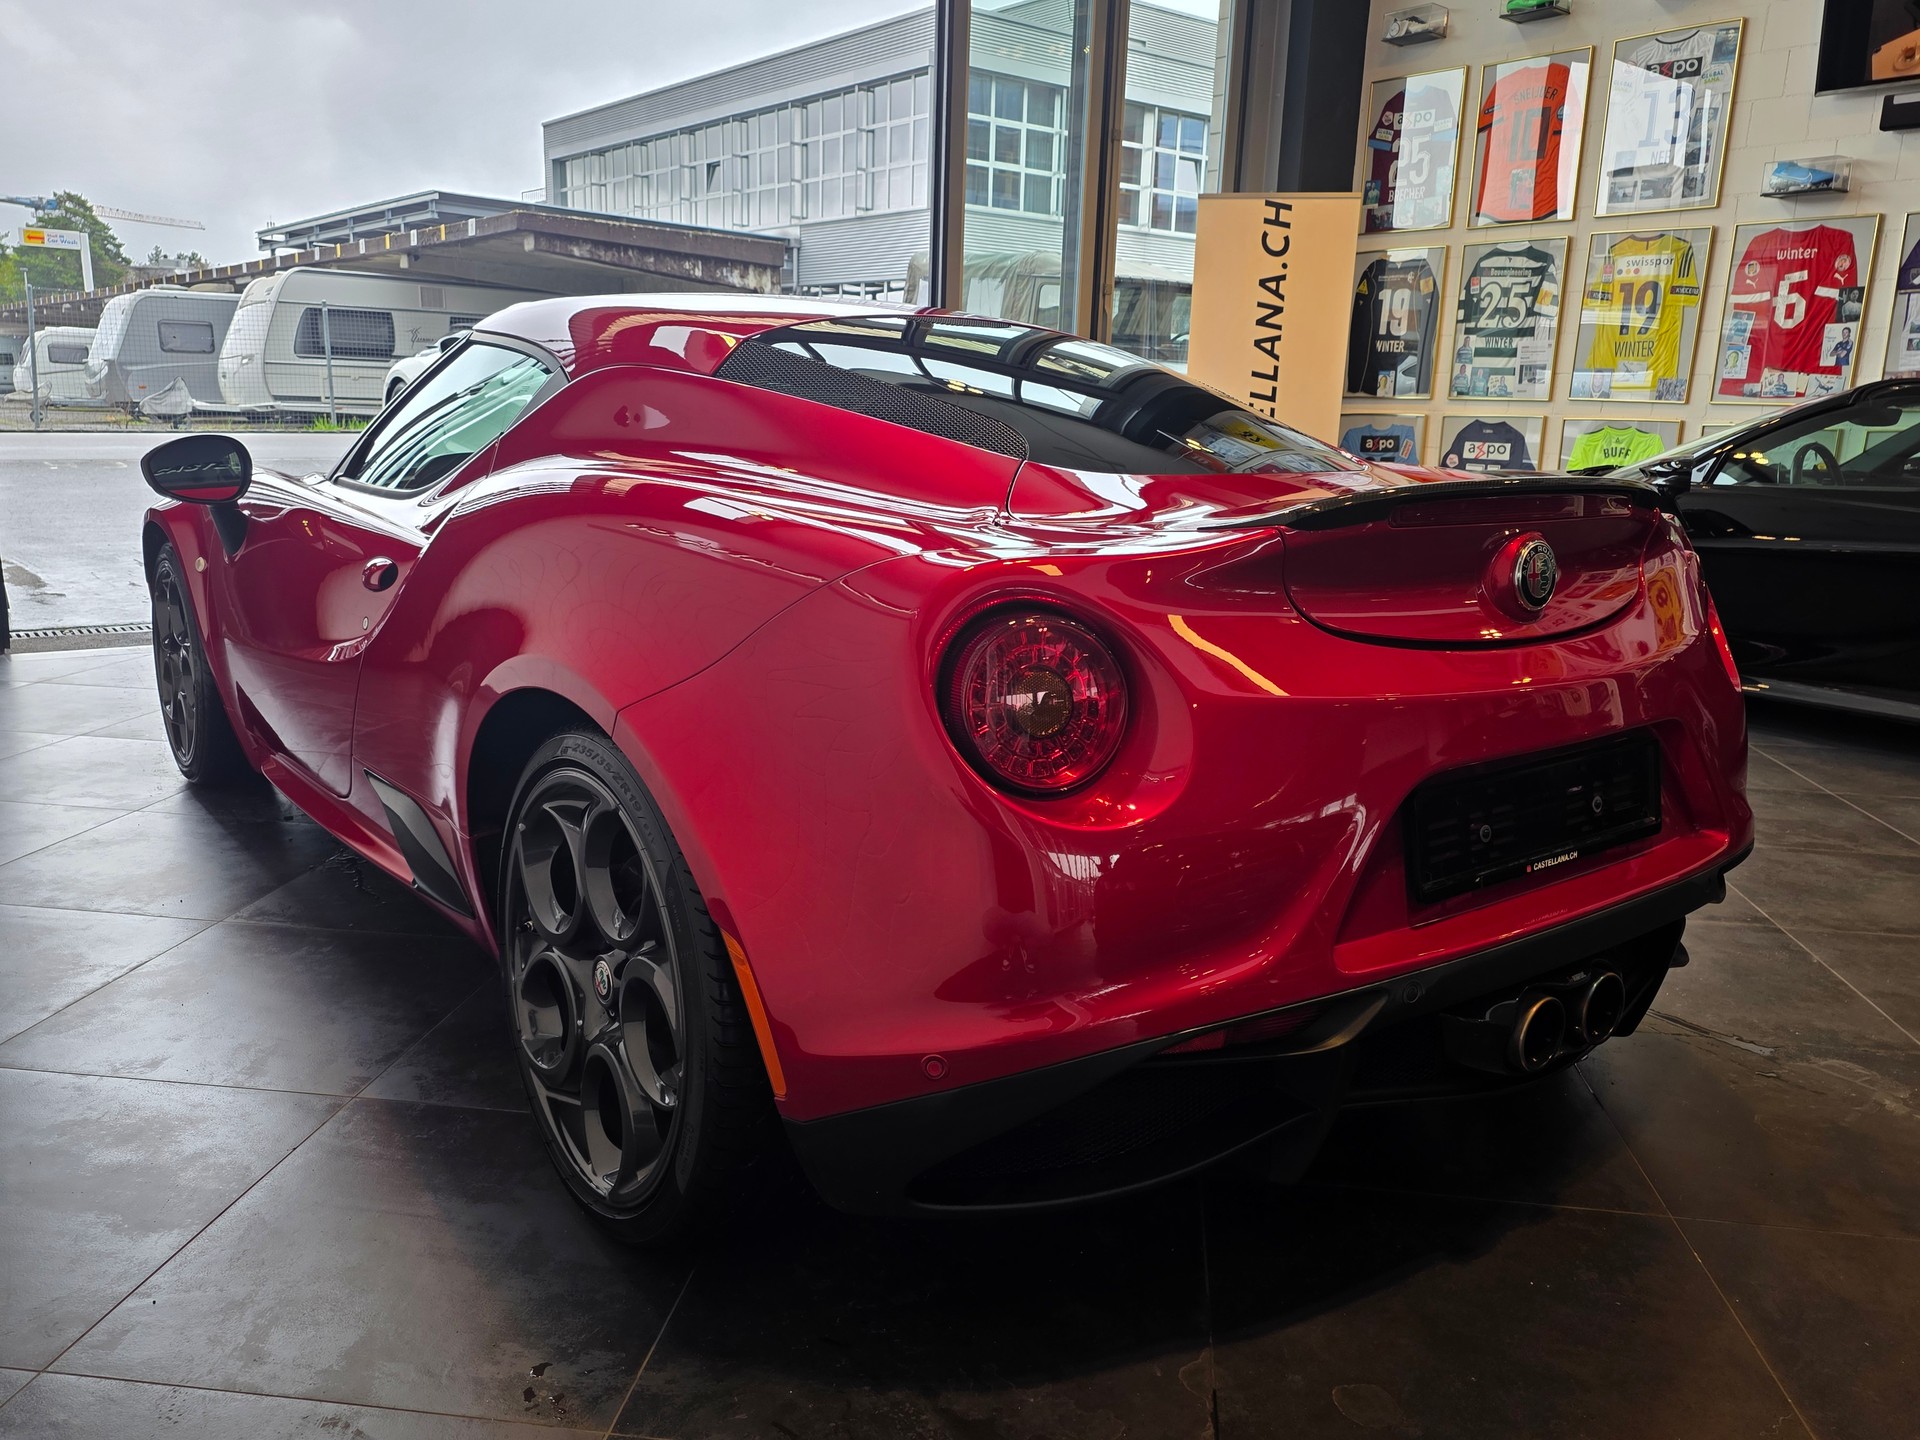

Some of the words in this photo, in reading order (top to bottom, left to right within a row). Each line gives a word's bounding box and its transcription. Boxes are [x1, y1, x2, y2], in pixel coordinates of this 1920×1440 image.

[1638, 85, 1696, 148] 13
[1508, 107, 1552, 163] 10
[1388, 133, 1432, 187] 25
[1776, 247, 1818, 260] winter
[1476, 280, 1532, 329] 25
[1619, 280, 1662, 336] 19
[1773, 270, 1808, 329] 6
[1378, 288, 1412, 336] 19
[1376, 340, 1405, 352] WINTER
[1484, 337, 1514, 348] WINTER
[1614, 341, 1655, 358] WINTER
[1365, 437, 1394, 452] axpo
[1468, 442, 1507, 459] axpo
[1603, 446, 1631, 459] BUFF
[1533, 850, 1578, 871] CASTELLANA.CH
